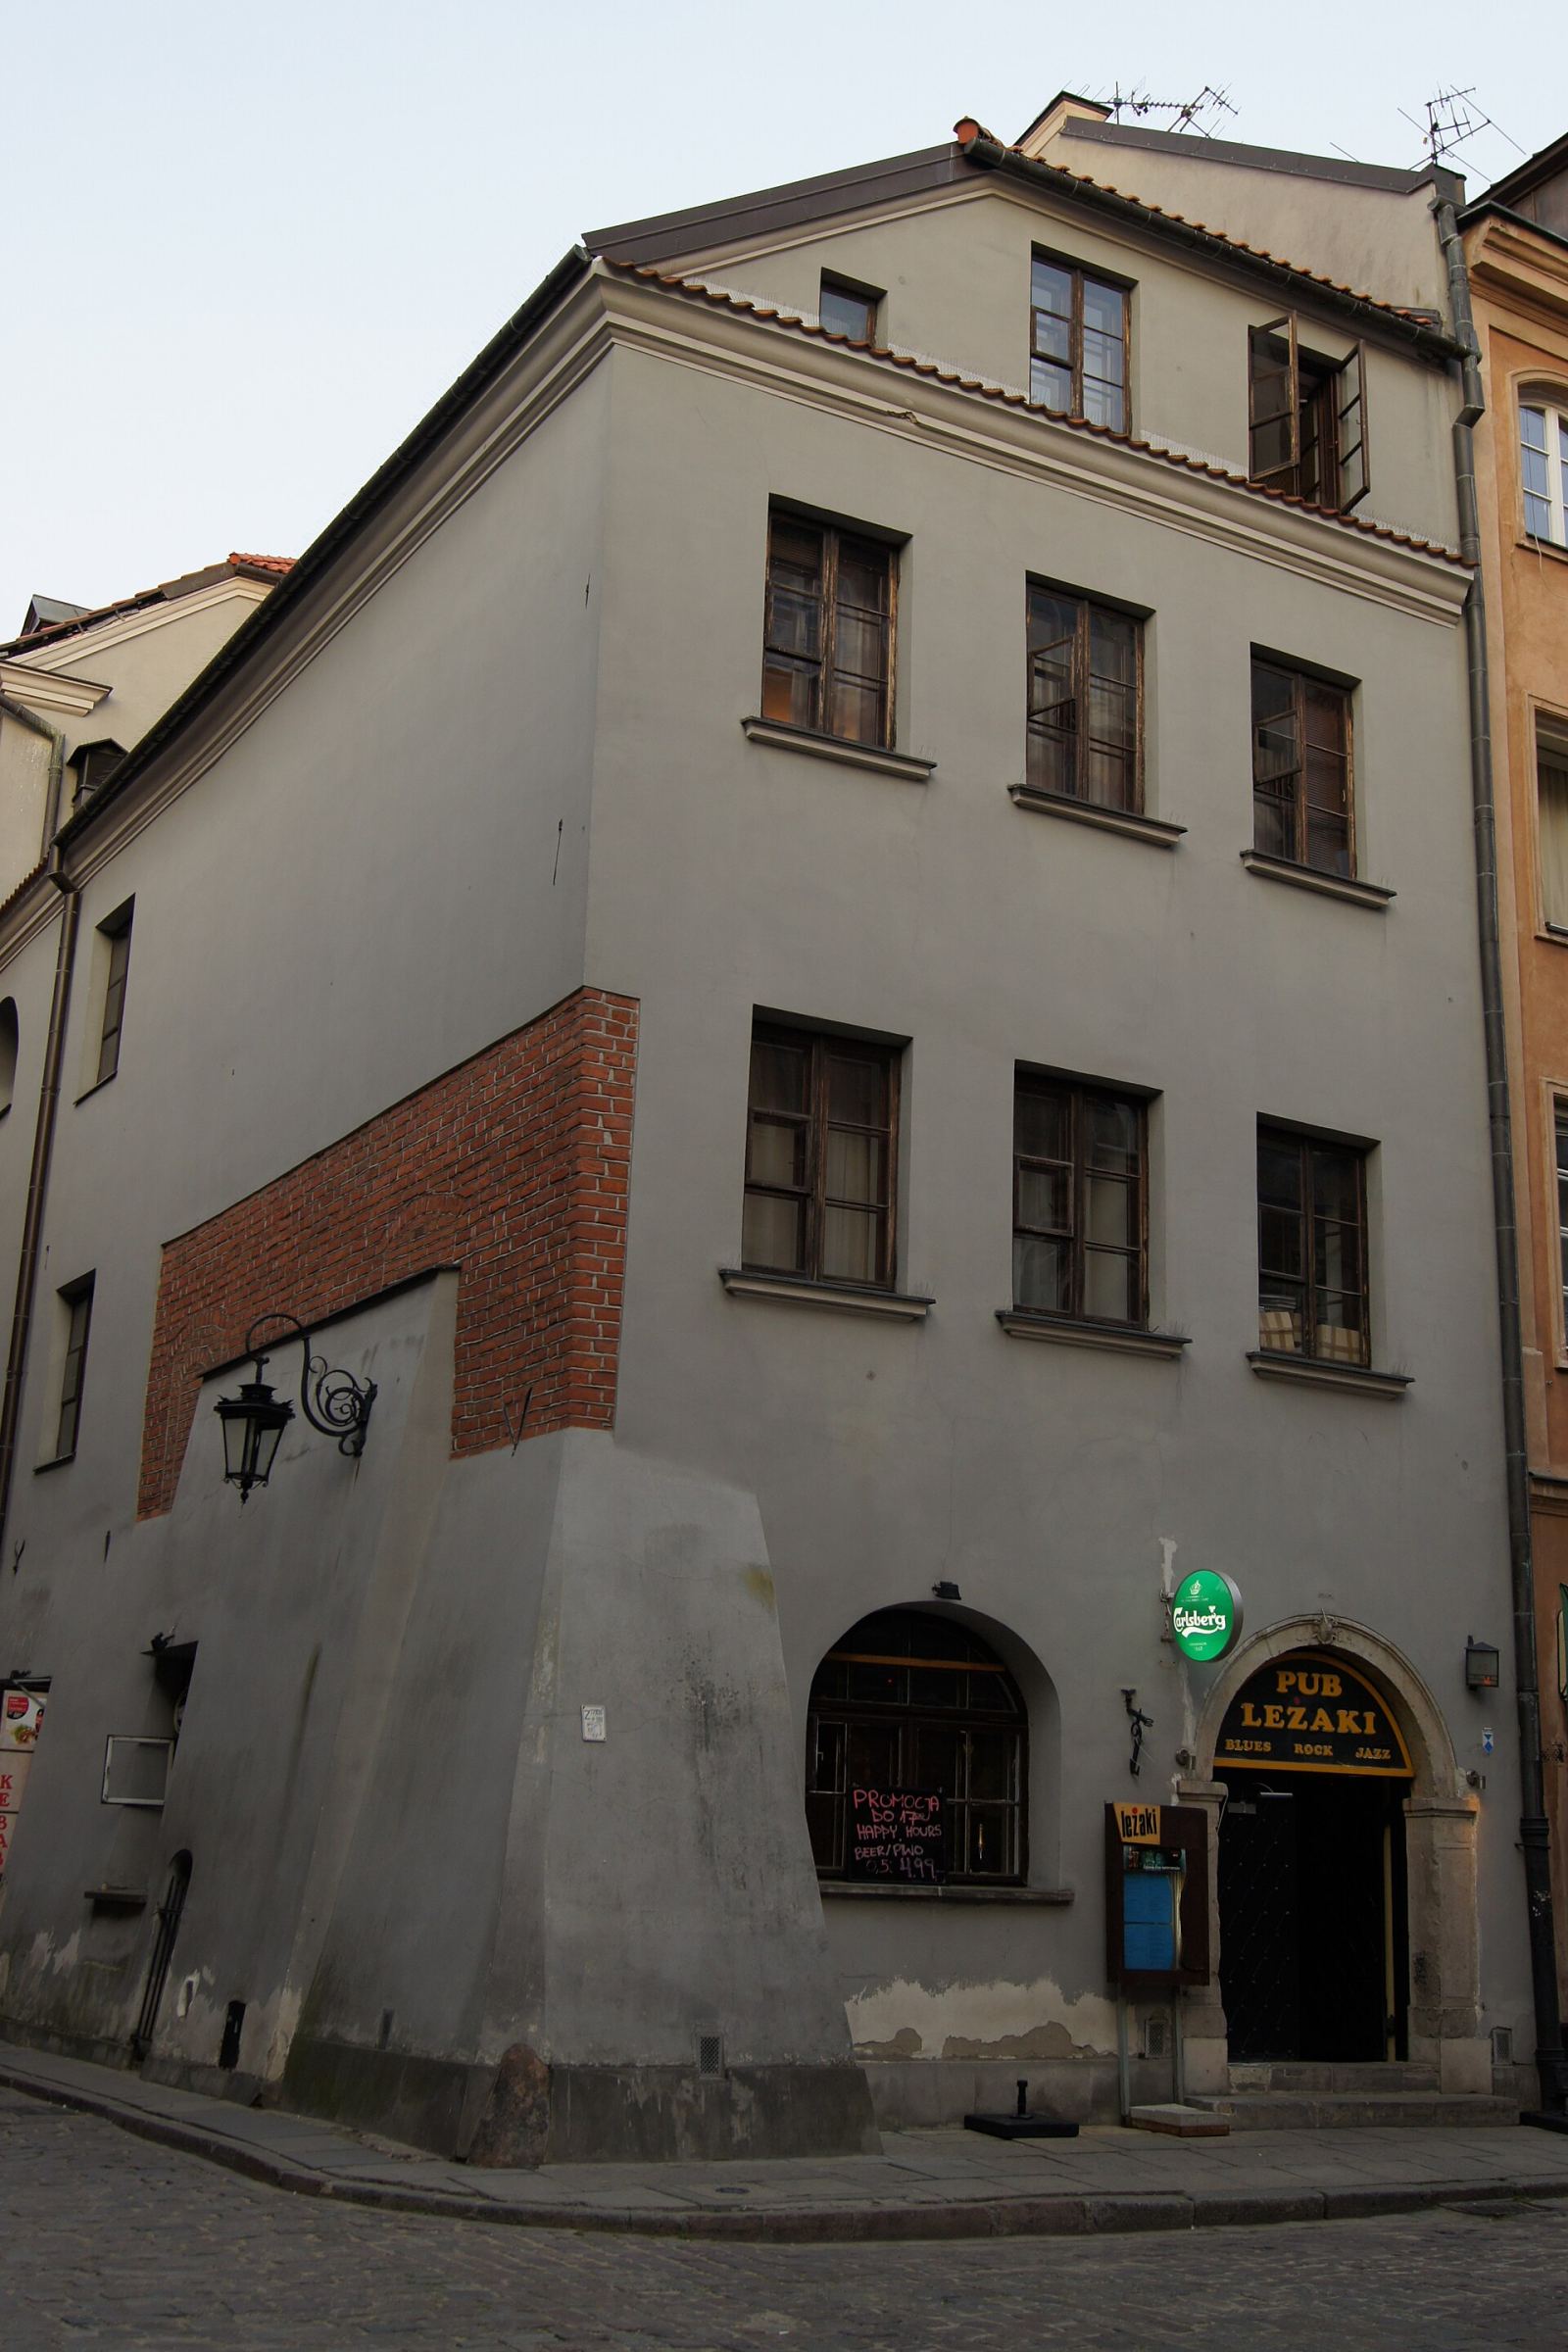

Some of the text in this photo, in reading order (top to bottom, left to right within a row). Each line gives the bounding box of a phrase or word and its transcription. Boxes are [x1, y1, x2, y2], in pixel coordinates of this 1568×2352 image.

[1173, 1604, 1226, 1634] Carlsberg
[1275, 1670, 1344, 1697] PUB
[1224, 1739, 1392, 1760] BLUES ROCK JAZZ
[853, 1788, 940, 1815] PROMOCJA
[871, 1808, 895, 1823] DO
[856, 1822, 942, 1840] HAPPY HOURS
